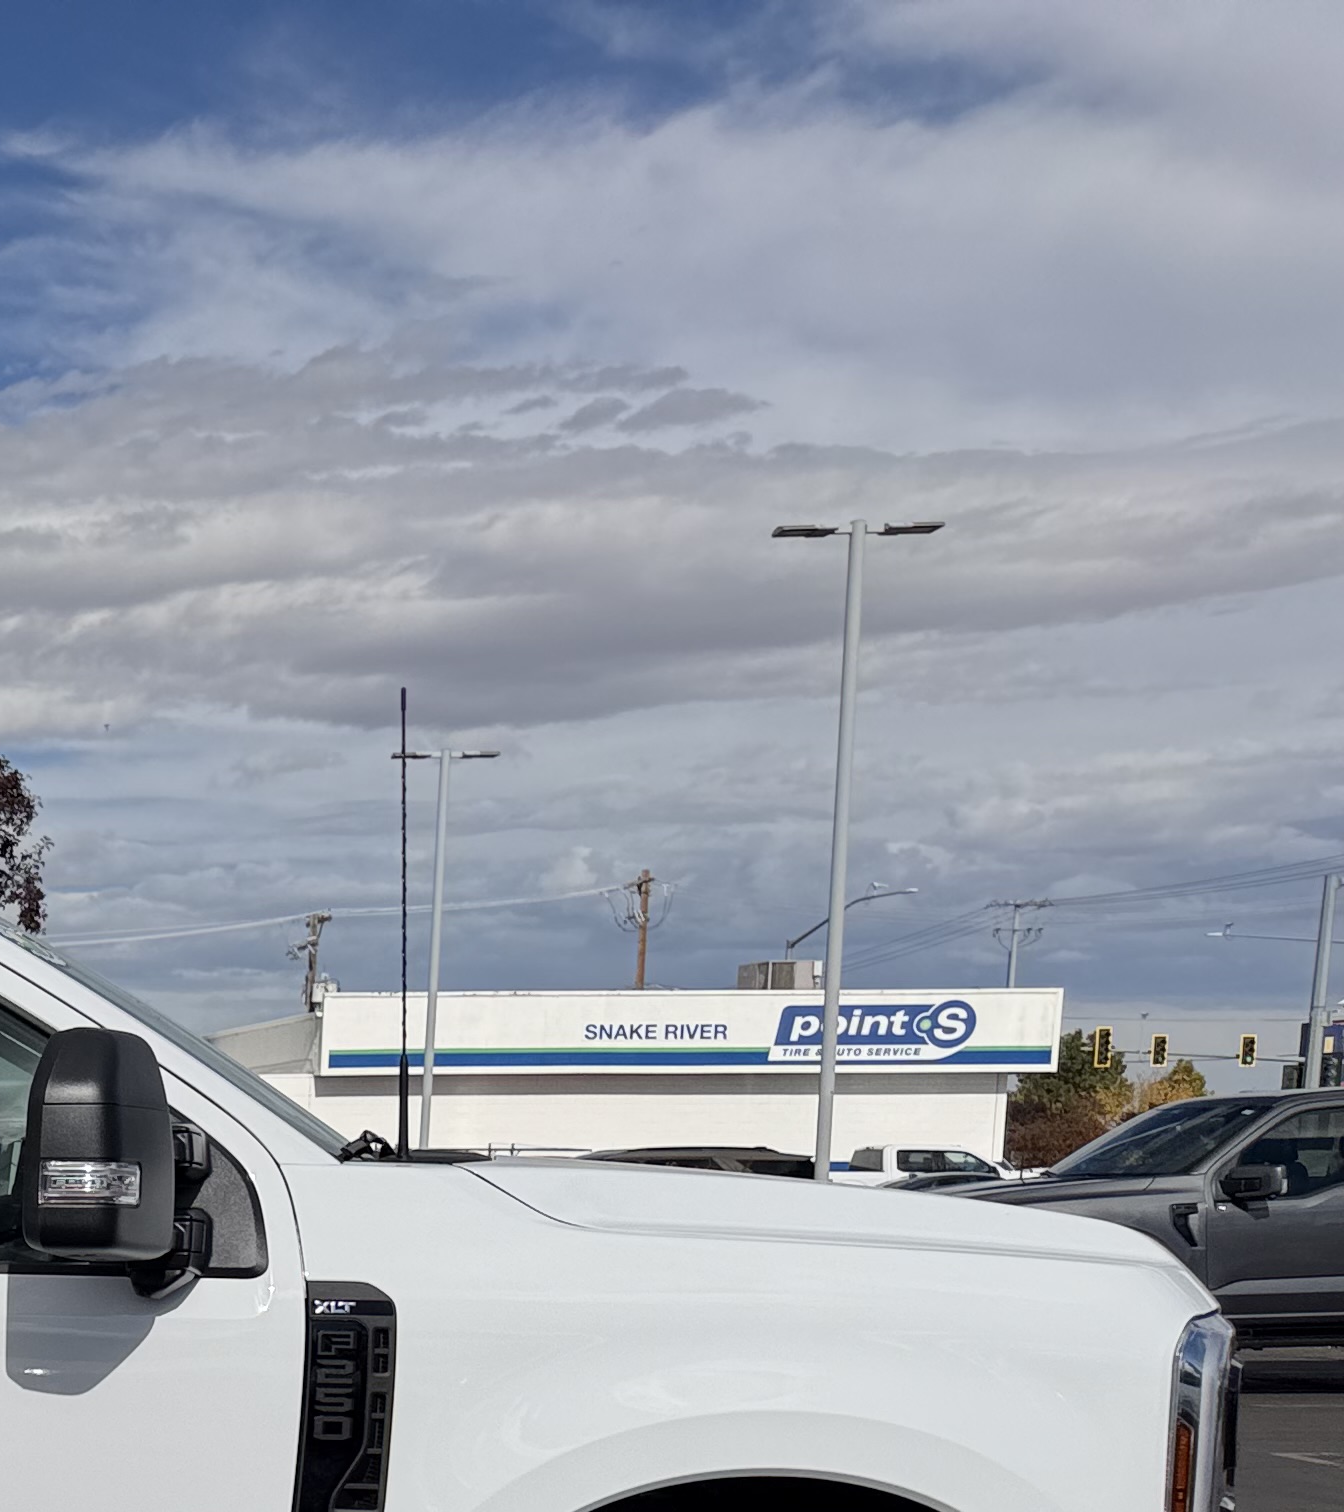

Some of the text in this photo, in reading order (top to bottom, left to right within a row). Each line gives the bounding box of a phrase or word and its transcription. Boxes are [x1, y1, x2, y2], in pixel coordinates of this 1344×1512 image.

[584, 1023, 728, 1041] SNAKE RIVER
[933, 1007, 968, 1041] S
[782, 1048, 810, 1057] TIRE
[835, 1047, 862, 1057] UTO
[867, 1047, 922, 1057] SERVICE
[314, 1300, 357, 1314] XLT
